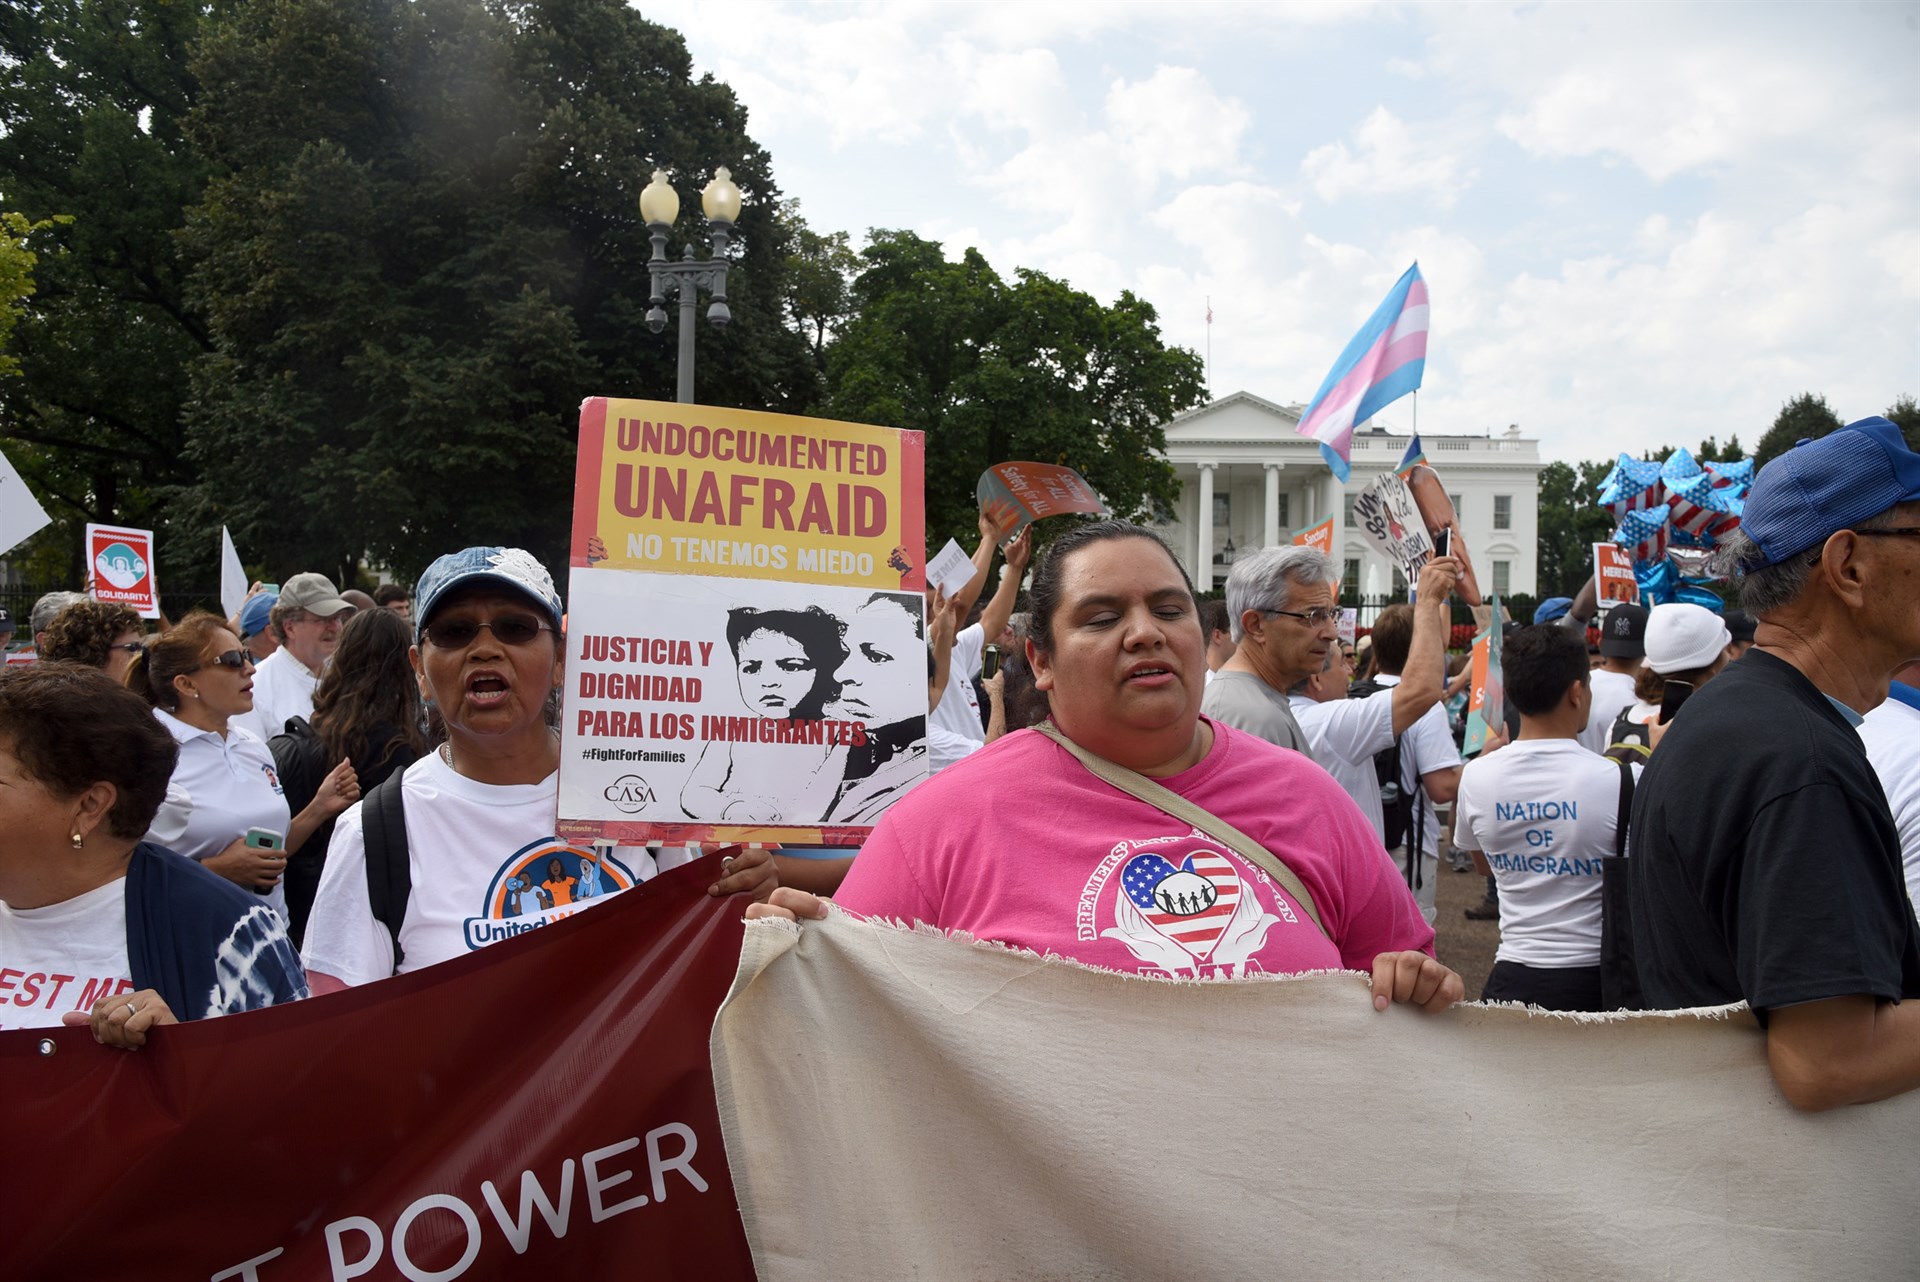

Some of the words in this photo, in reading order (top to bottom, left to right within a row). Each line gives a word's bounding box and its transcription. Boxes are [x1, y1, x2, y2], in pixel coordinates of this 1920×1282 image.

[617, 417, 887, 477] UNDOCUMENTED
[614, 463, 887, 538] UNAFRAID
[1001, 466, 1029, 491] Safety
[1028, 500, 1051, 515] ALL
[1046, 486, 1069, 499] ALL
[1365, 515, 1387, 540] go
[626, 532, 663, 560] NO
[670, 536, 788, 570] TENEMOS
[797, 547, 874, 577] MIEDO
[97, 589, 150, 602] SOLIDARITY
[580, 635, 693, 666] JUSTICIA
[698, 641, 713, 667] Y
[579, 672, 702, 703] DIGNIDAD
[577, 710, 644, 739] PARA
[649, 712, 695, 741] LOS
[701, 715, 867, 748] INMIGRANTES
[582, 748, 686, 763] #FightForFamilies
[603, 785, 658, 803] CASA
[1496, 800, 1577, 821] NATION
[1526, 829, 1553, 848] OF
[1077, 841, 1129, 941] DREAMERS'
[475, 916, 547, 943] United
[323, 1121, 709, 1282] POWER
